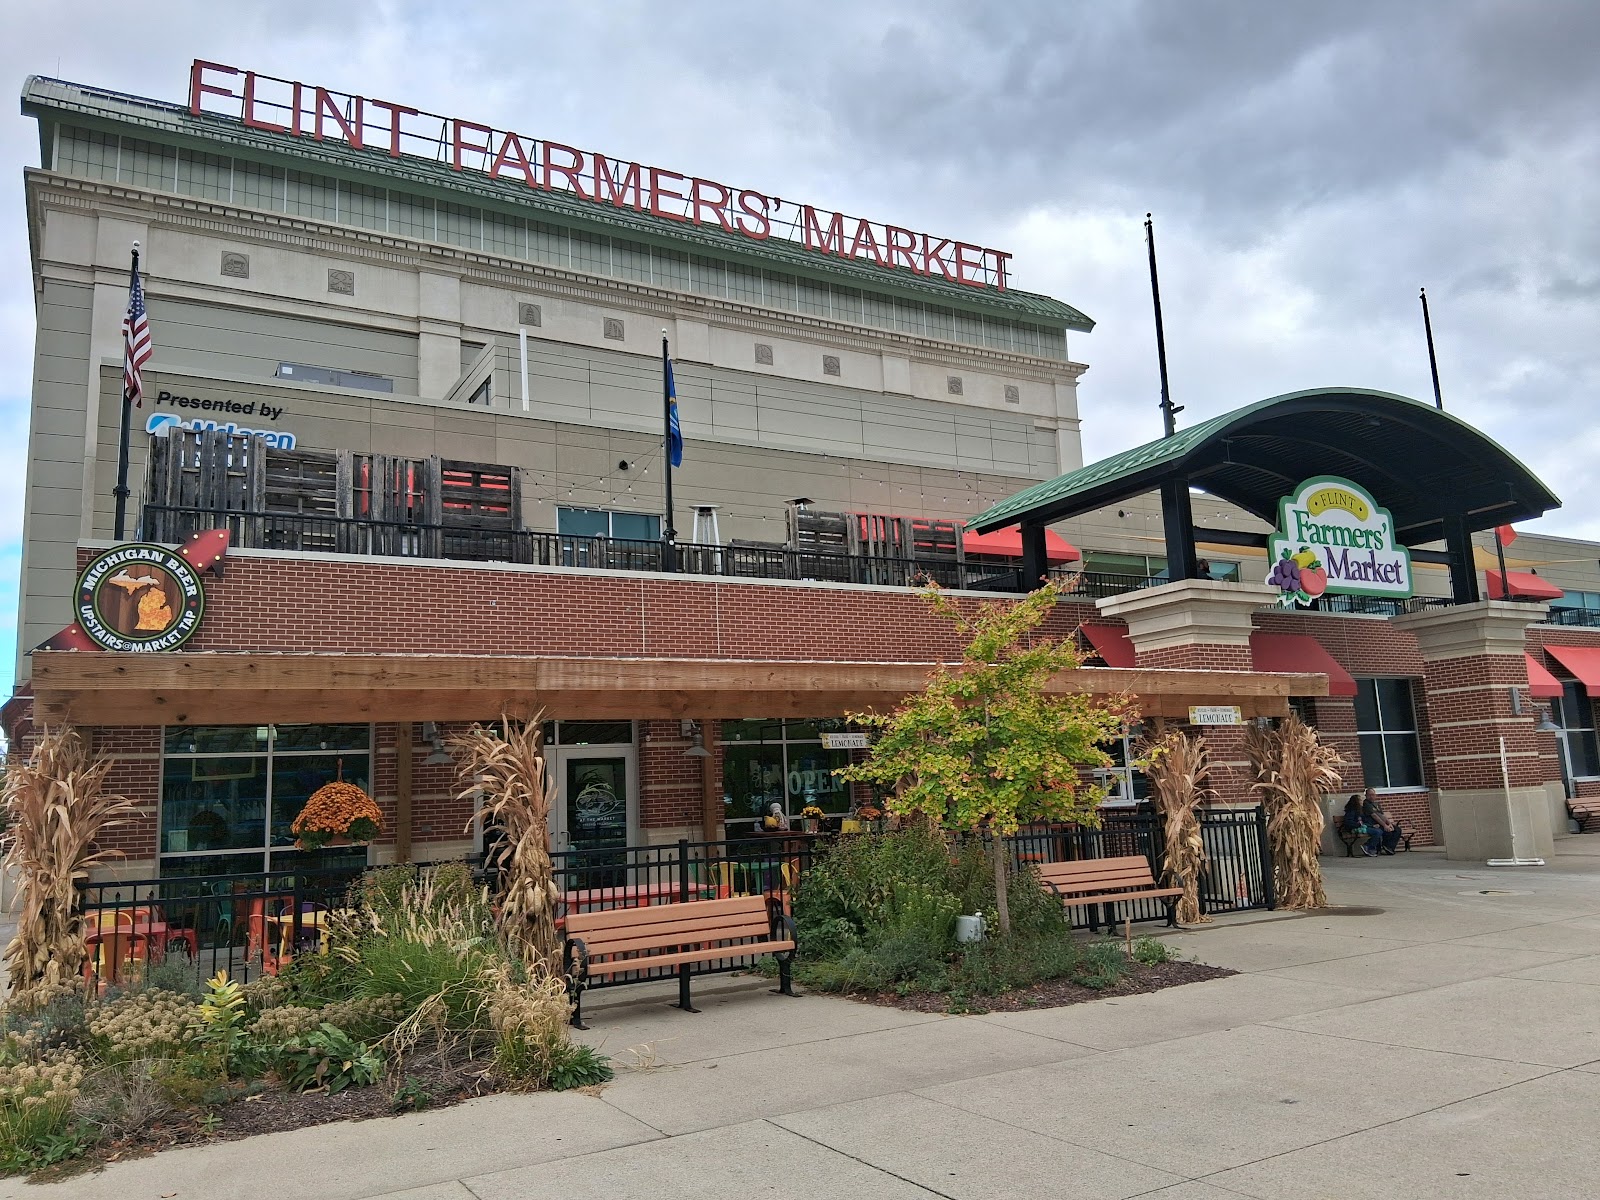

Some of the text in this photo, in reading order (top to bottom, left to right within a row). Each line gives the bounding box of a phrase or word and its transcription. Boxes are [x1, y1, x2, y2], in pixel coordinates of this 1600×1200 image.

[191, 59, 1013, 292] FLINT FARMERS' MARKET
[156, 391, 283, 420] Presented by
[1320, 492, 1356, 510] FLINT
[1292, 509, 1387, 551] Farmers'
[82, 549, 198, 597] MICHIGAN BEER
[1323, 546, 1404, 585] Market
[178, 610, 197, 631] TAP
[1199, 713, 1234, 723] LEMONADE
[788, 769, 845, 796] OPEN
